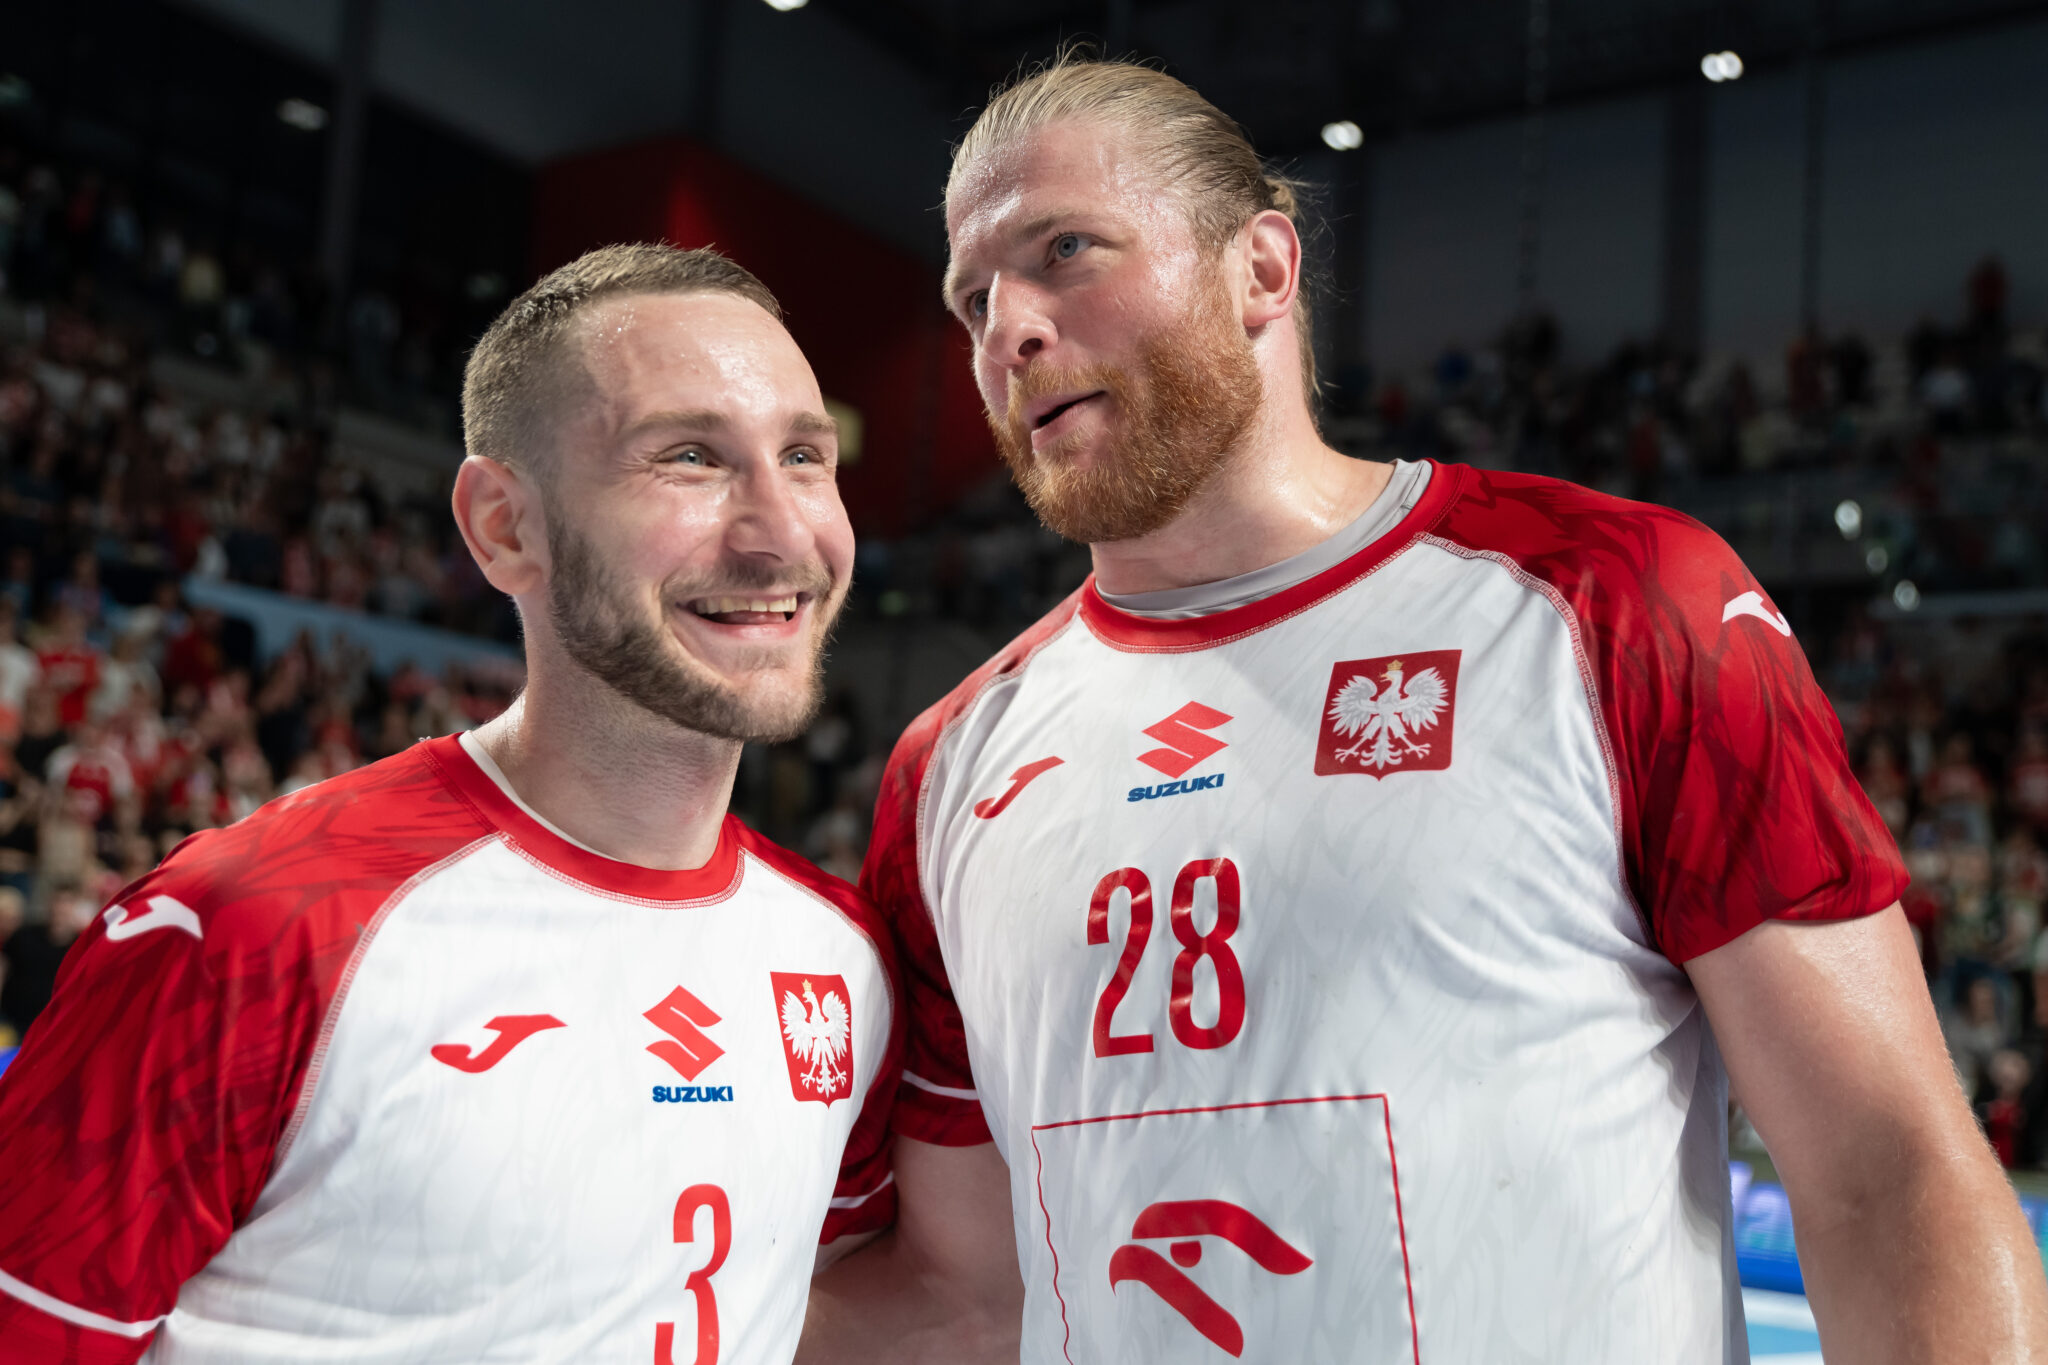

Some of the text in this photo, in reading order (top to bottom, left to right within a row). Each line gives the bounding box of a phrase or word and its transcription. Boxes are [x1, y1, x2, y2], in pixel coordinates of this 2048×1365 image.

[1127, 773, 1225, 802] SUZUKI
[1087, 857, 1246, 1058] 28
[652, 1085, 734, 1103] SUZUKI
[654, 1183, 732, 1365] 3
